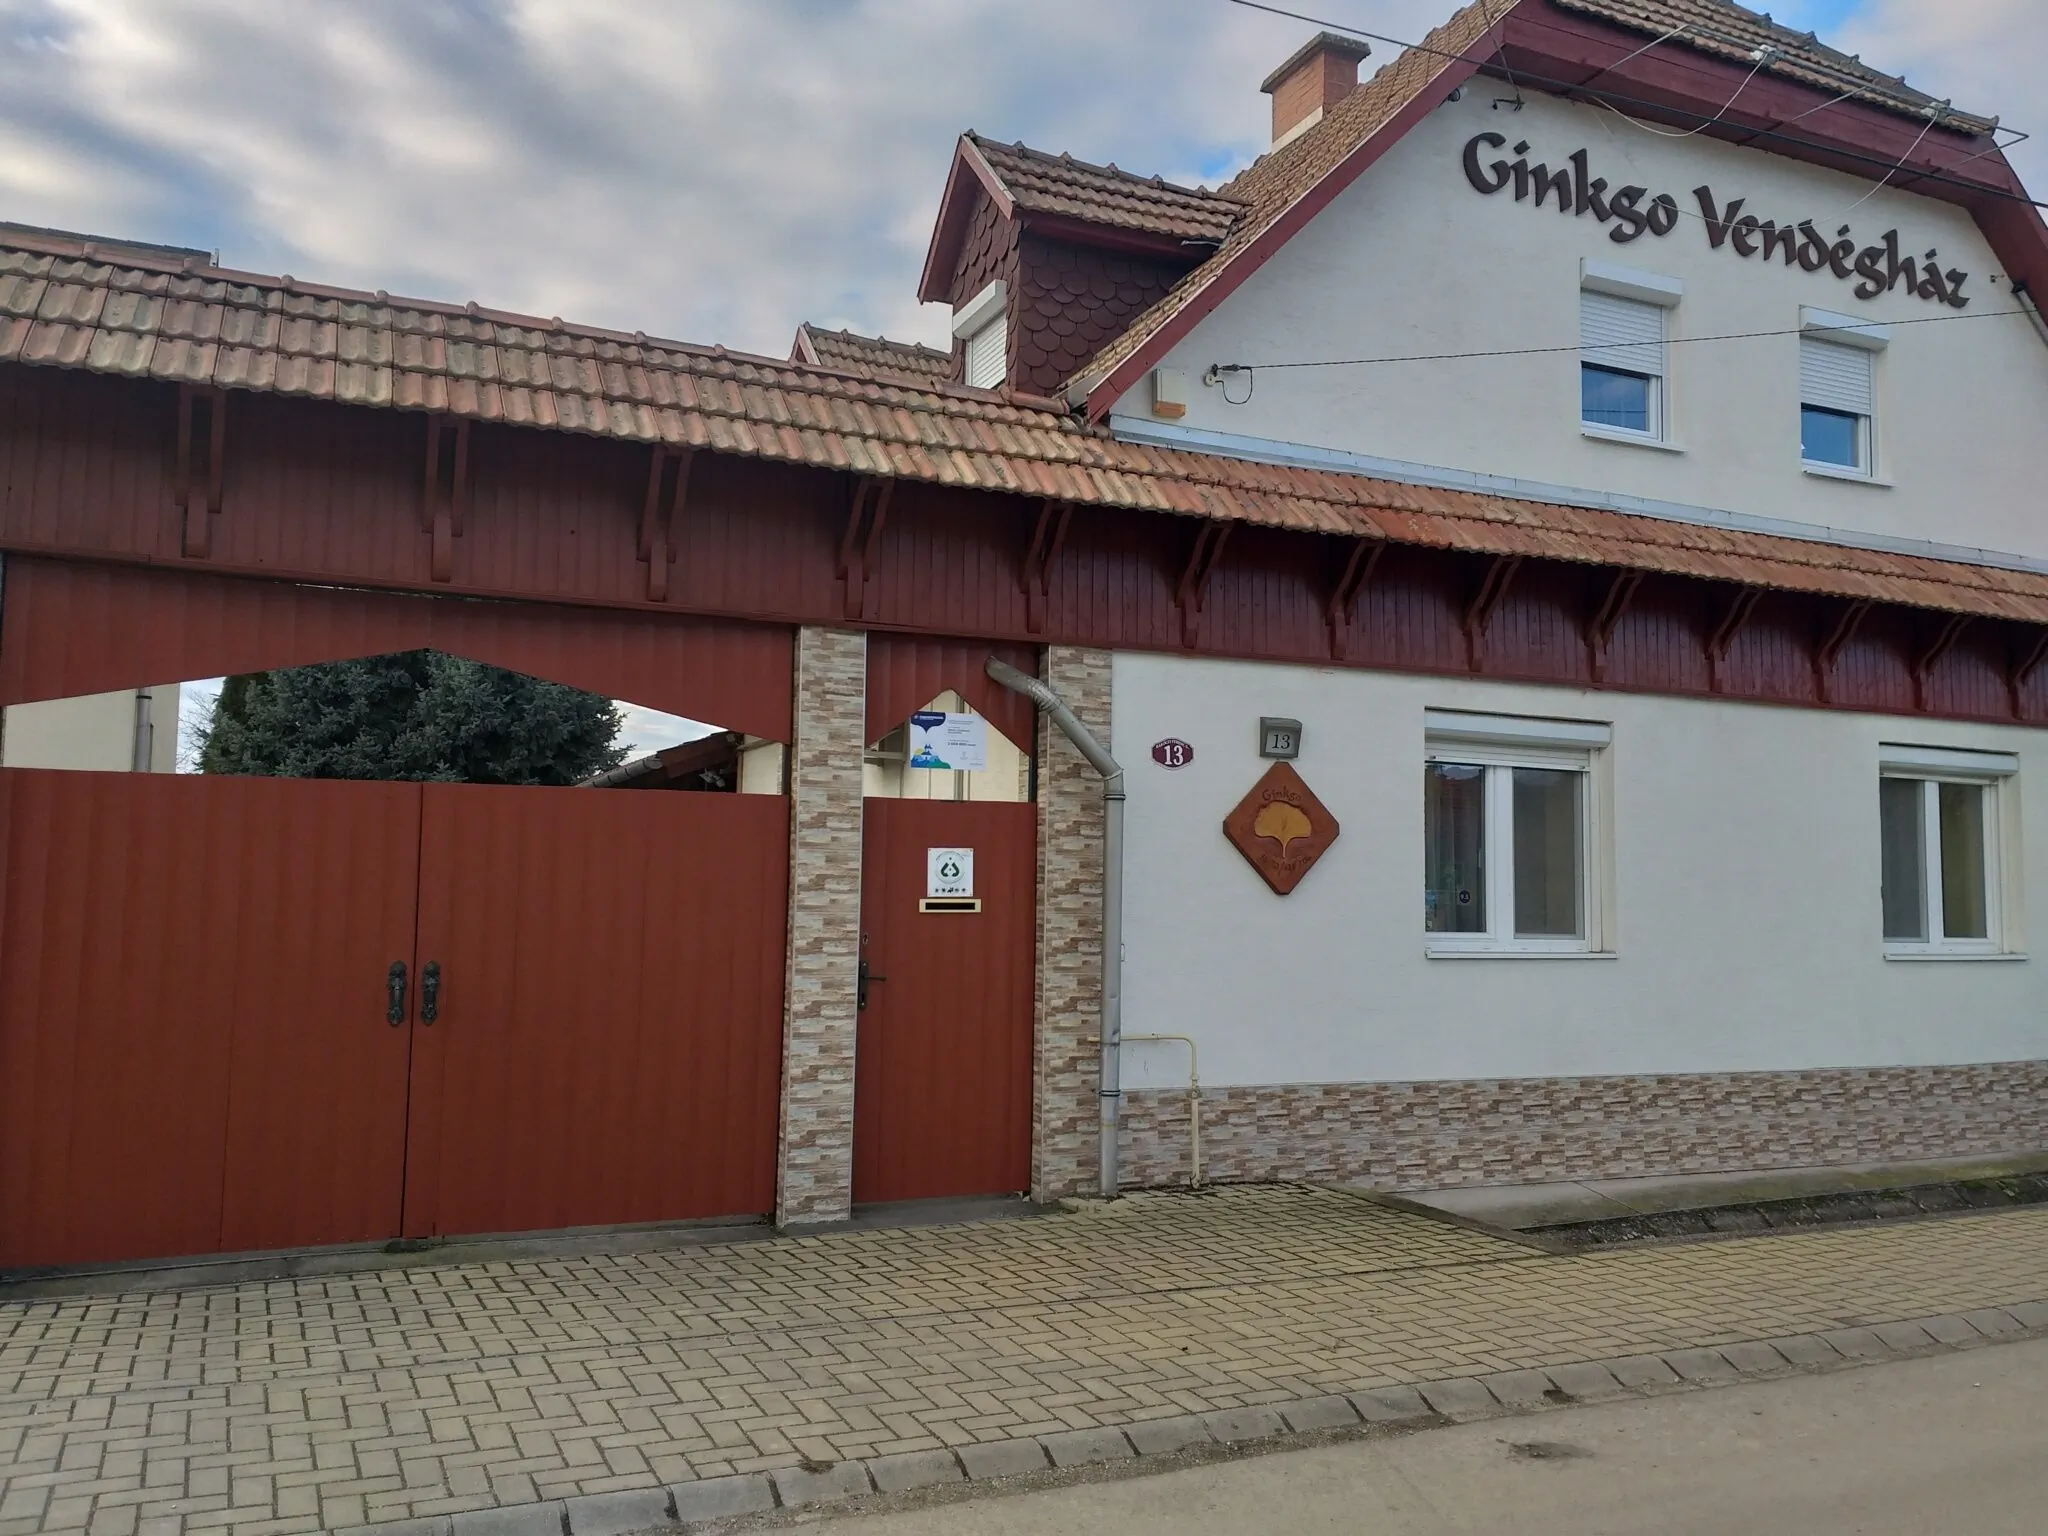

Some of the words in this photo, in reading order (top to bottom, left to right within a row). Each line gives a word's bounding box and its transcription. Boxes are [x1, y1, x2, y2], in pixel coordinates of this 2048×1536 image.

[1463, 132, 1679, 243] Ginkgo
[1693, 185, 1970, 308] Vendégház
[1272, 734, 1290, 749] 13
[1164, 745, 1183, 765] 13
